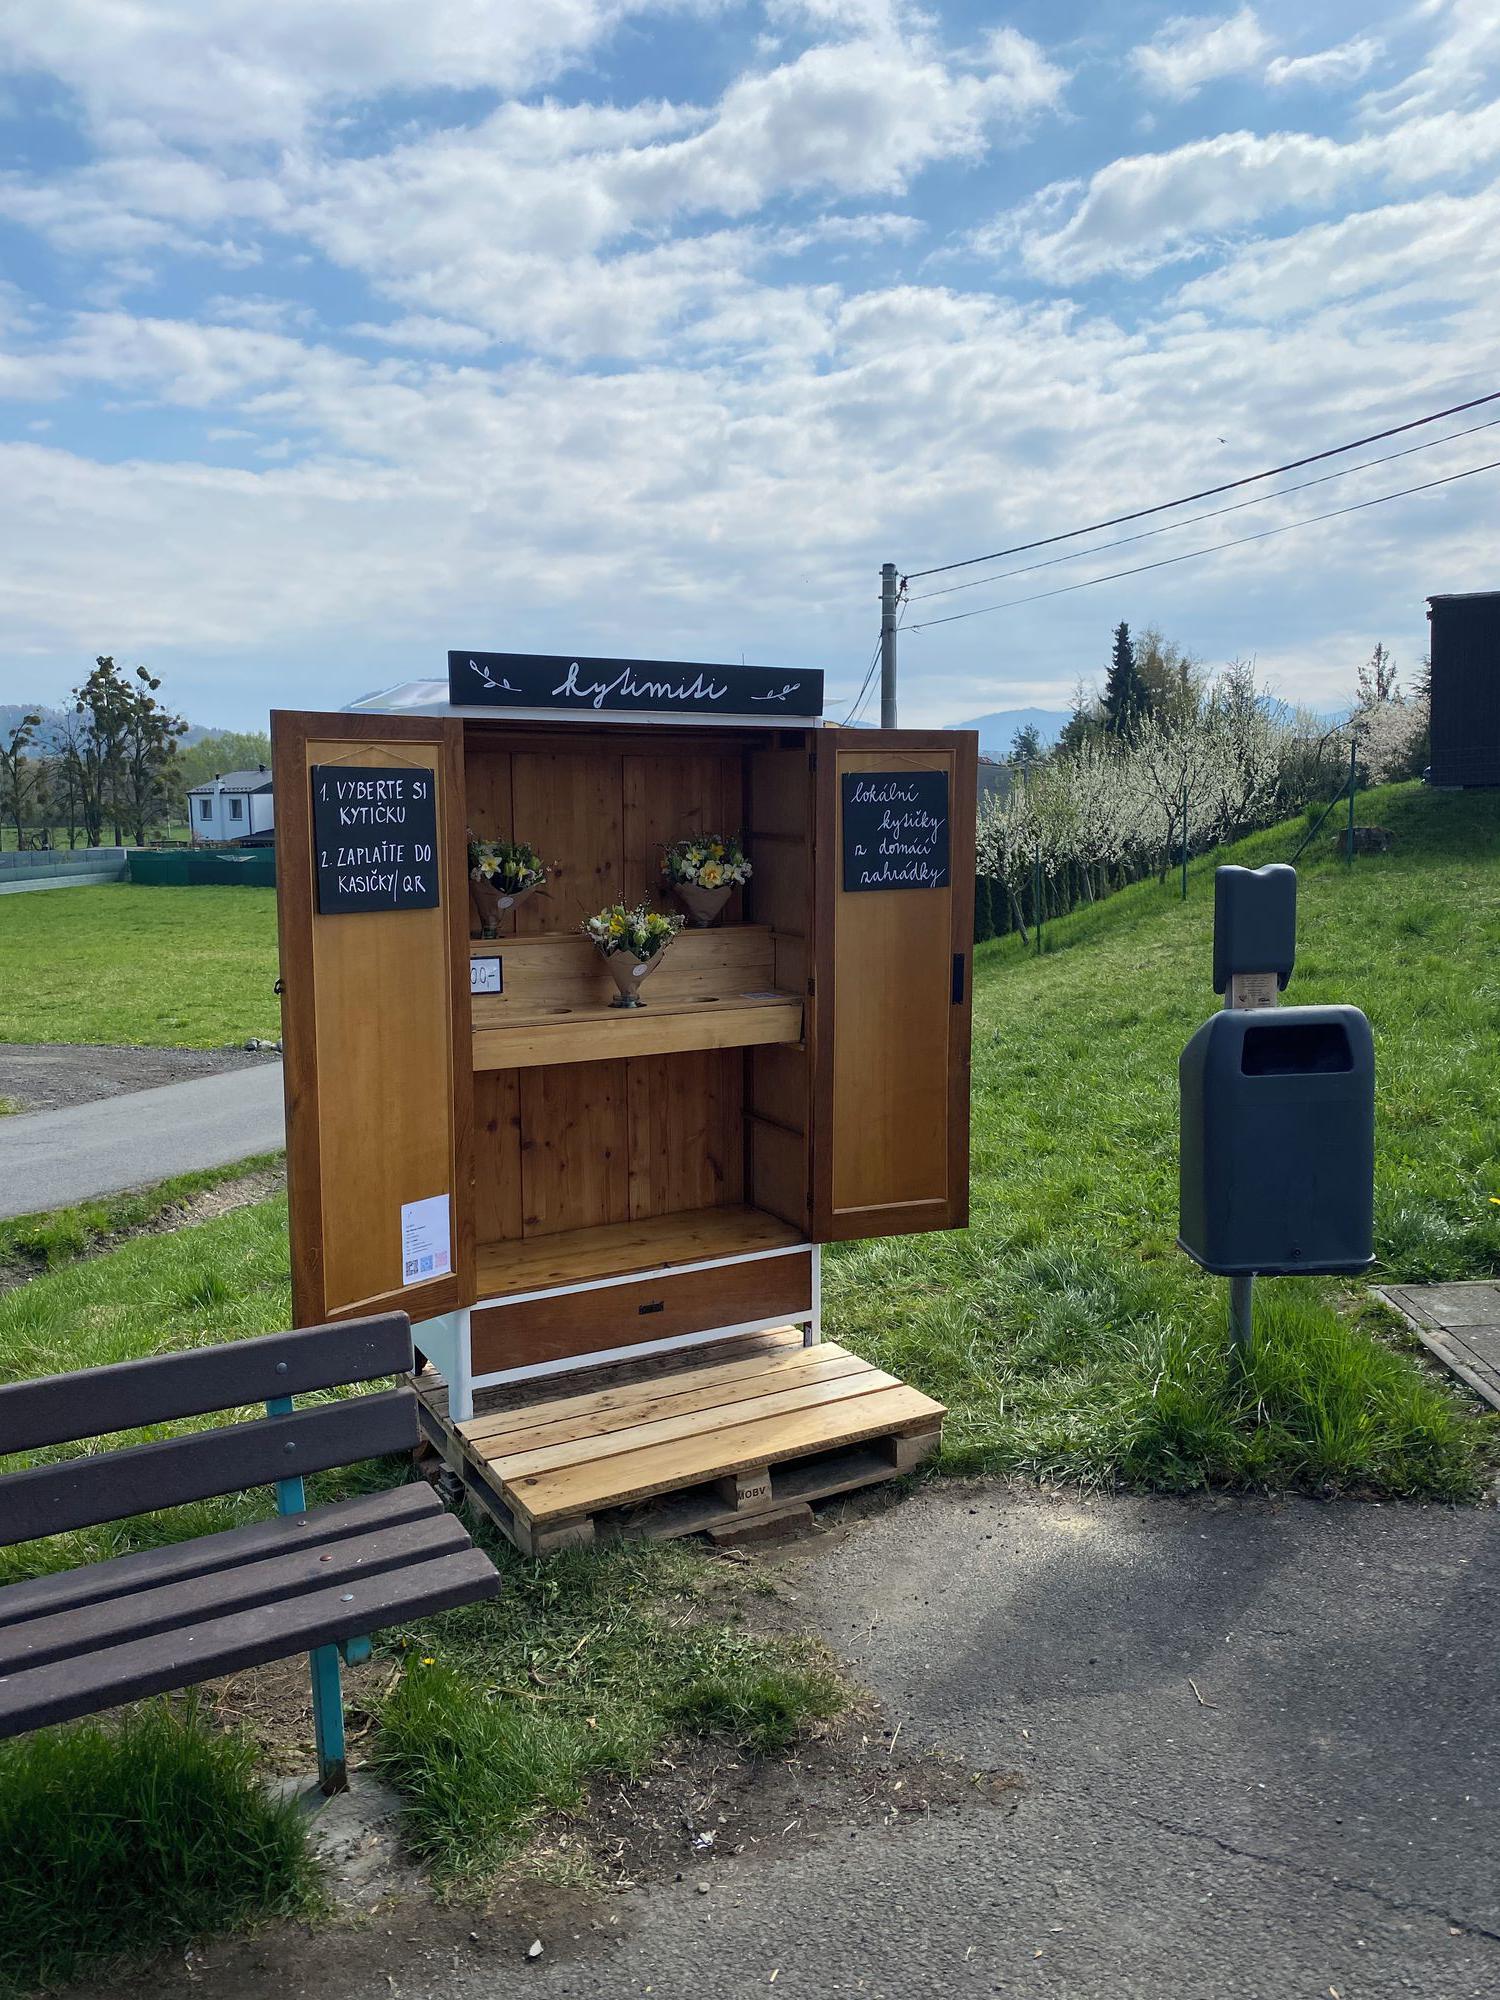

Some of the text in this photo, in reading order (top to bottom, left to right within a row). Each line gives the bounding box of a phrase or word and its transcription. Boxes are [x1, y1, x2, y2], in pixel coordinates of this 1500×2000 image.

[319, 780, 427, 802] 1. VYBERTE SI
[850, 782, 919, 803] lokální
[339, 801, 406, 826] KYTIČKU
[877, 809, 946, 845] kytičky
[337, 840, 405, 867] ZAPLAŤTE
[414, 844, 431, 863] DO
[879, 837, 932, 855] domácí
[402, 875, 426, 893] QR
[860, 860, 946, 889] zahrádky
